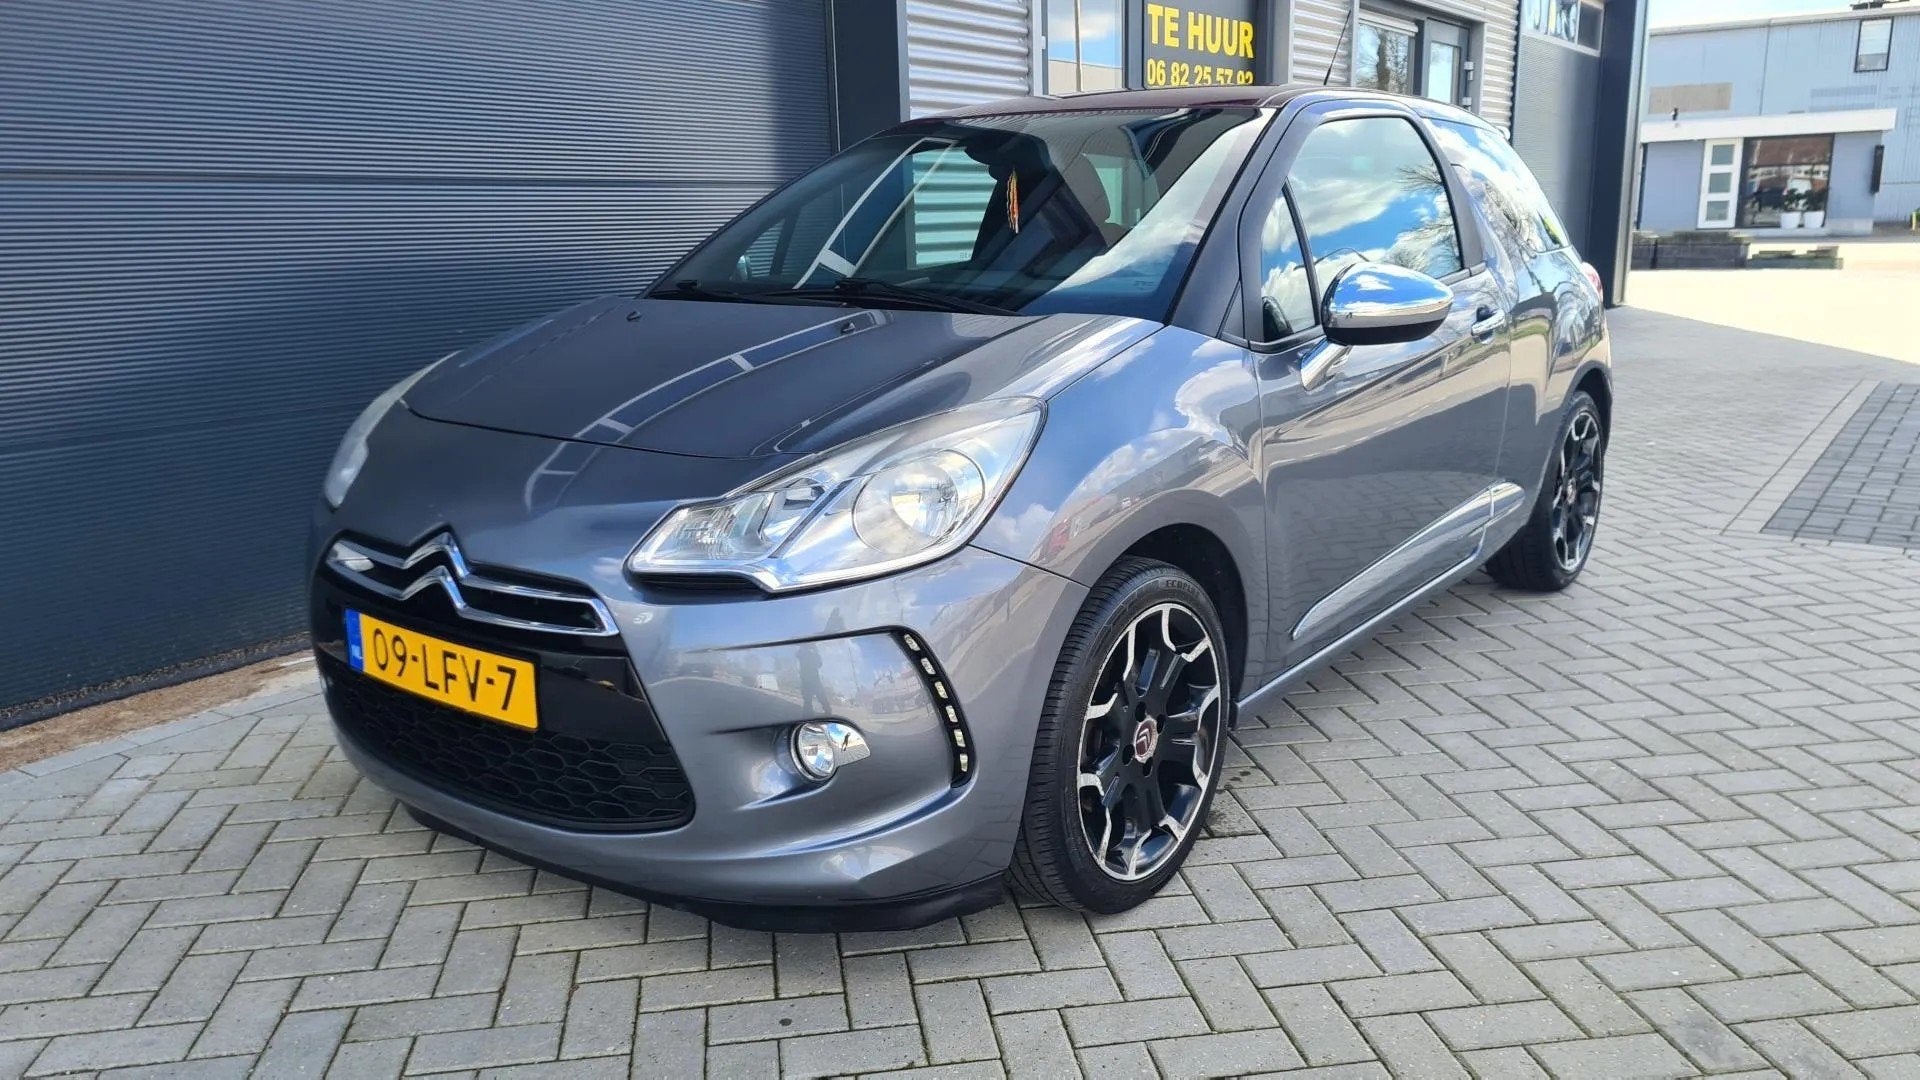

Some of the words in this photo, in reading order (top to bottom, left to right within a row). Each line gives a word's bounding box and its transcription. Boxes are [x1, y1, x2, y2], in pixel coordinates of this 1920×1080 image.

[1147, 3, 1180, 48] TE
[1187, 11, 1254, 59] HUUR
[1147, 58, 1166, 86] 06
[1170, 61, 1190, 87] 82
[1193, 64, 1212, 85] 25
[1216, 67, 1234, 85] 57
[374, 628, 517, 710] 09-LFV-7
